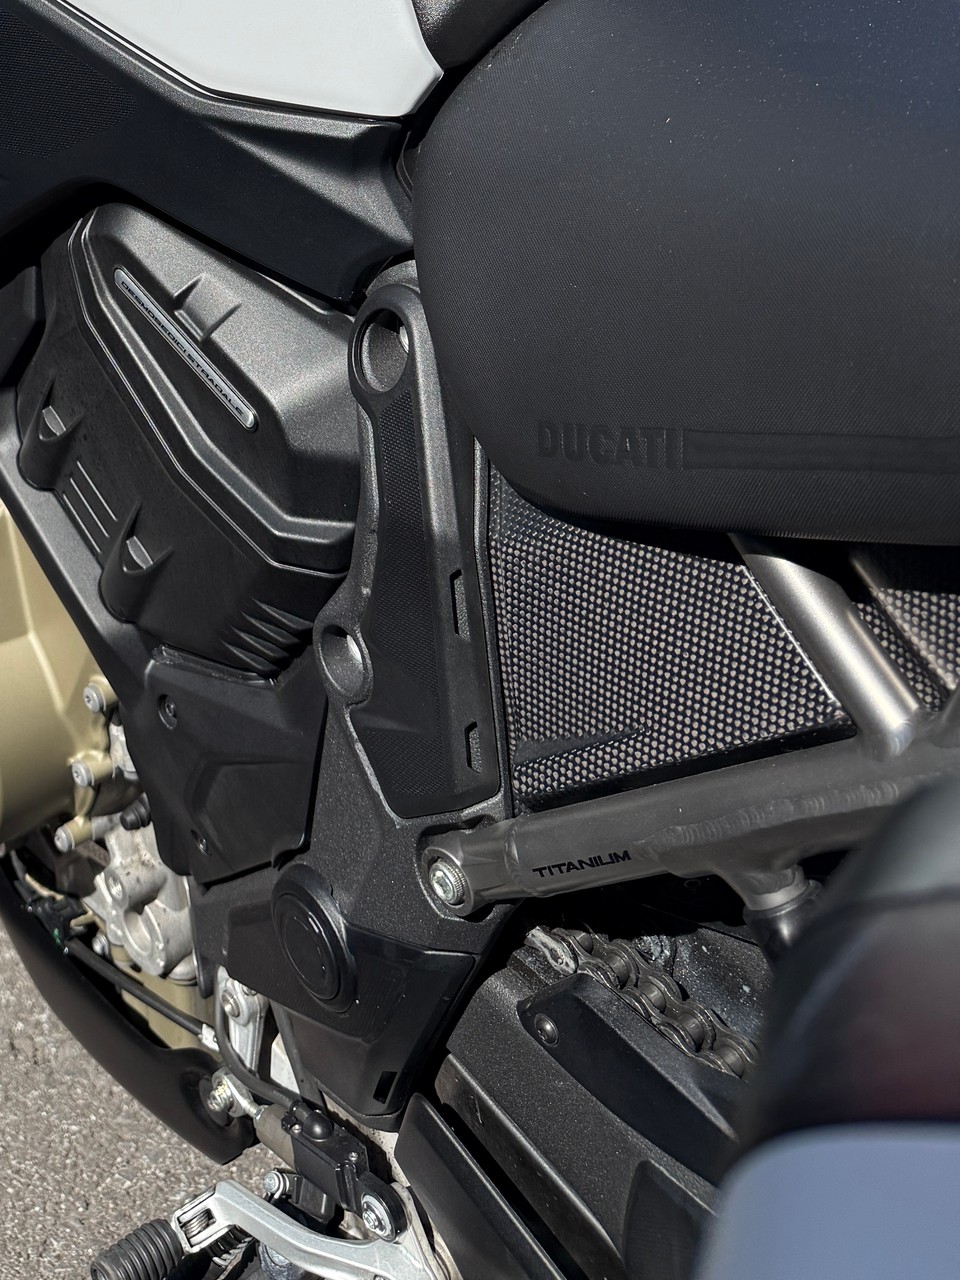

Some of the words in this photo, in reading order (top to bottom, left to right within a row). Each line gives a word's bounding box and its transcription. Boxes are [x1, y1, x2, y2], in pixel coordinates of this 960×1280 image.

[121, 280, 187, 354] DESMOSEDICI
[187, 352, 245, 417] STRADALE
[537, 421, 683, 471] DUCATI
[532, 849, 632, 878] TITANIUM
